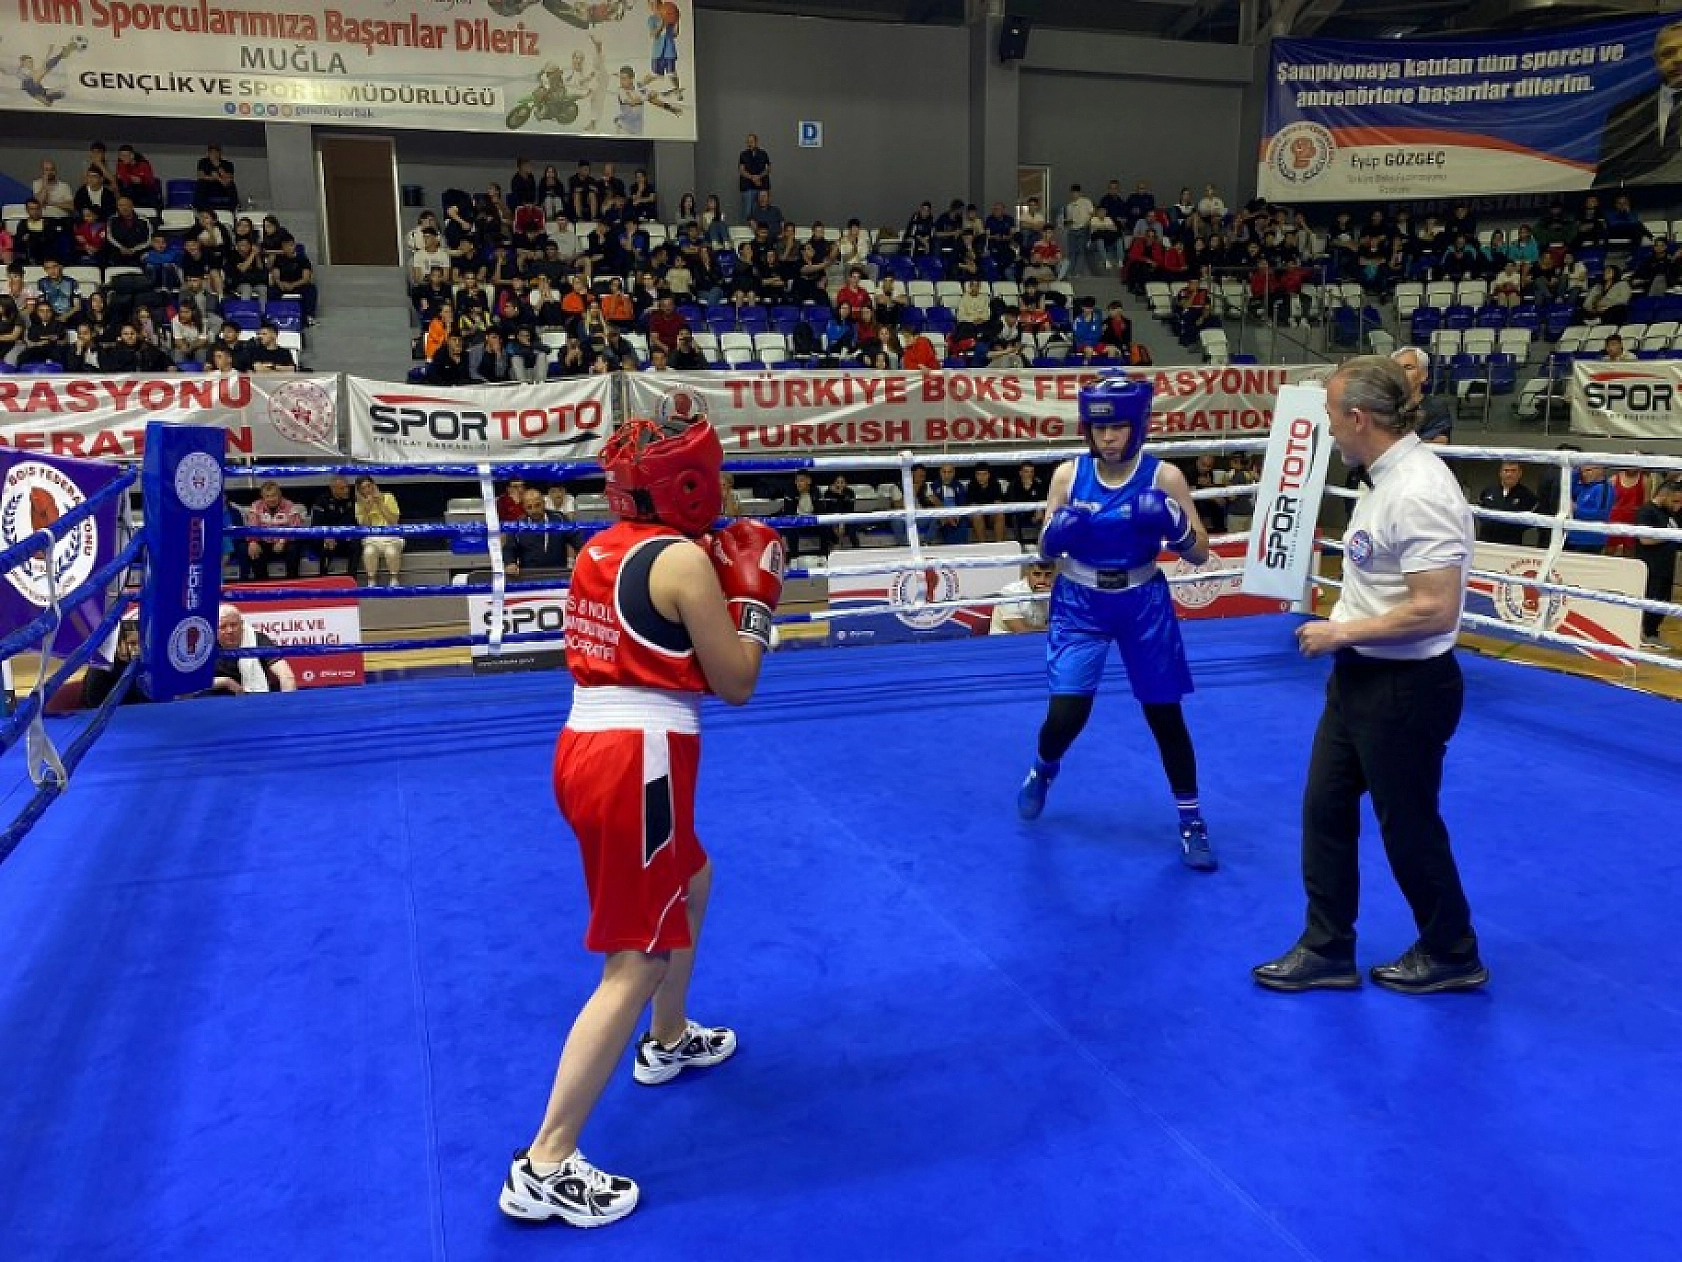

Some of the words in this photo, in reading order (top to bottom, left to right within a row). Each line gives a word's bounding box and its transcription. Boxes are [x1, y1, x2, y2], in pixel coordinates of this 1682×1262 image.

[90, 0, 318, 40] Sporcularımıza
[323, 9, 447, 56] Başarılar
[455, 17, 540, 56] Dileriz
[240, 44, 348, 74] MUĞLA
[1277, 62, 1401, 85] Şampiyonaya
[1403, 58, 1474, 78] katılan
[1477, 54, 1517, 73] tüm
[1521, 47, 1596, 71] sporcu
[1599, 44, 1624, 62] ve
[79, 71, 193, 94] GENÇLİK
[200, 79, 232, 95] VE
[340, 83, 496, 106] MÜDÜRLÜĞÜ
[1296, 86, 1415, 107] antrenörlere
[1418, 80, 1510, 105] başarılar
[724, 372, 907, 409] TÜRKİYE
[922, 374, 1022, 402] BOKS
[731, 420, 911, 449] TURKISH
[926, 416, 1064, 441] BOXING
